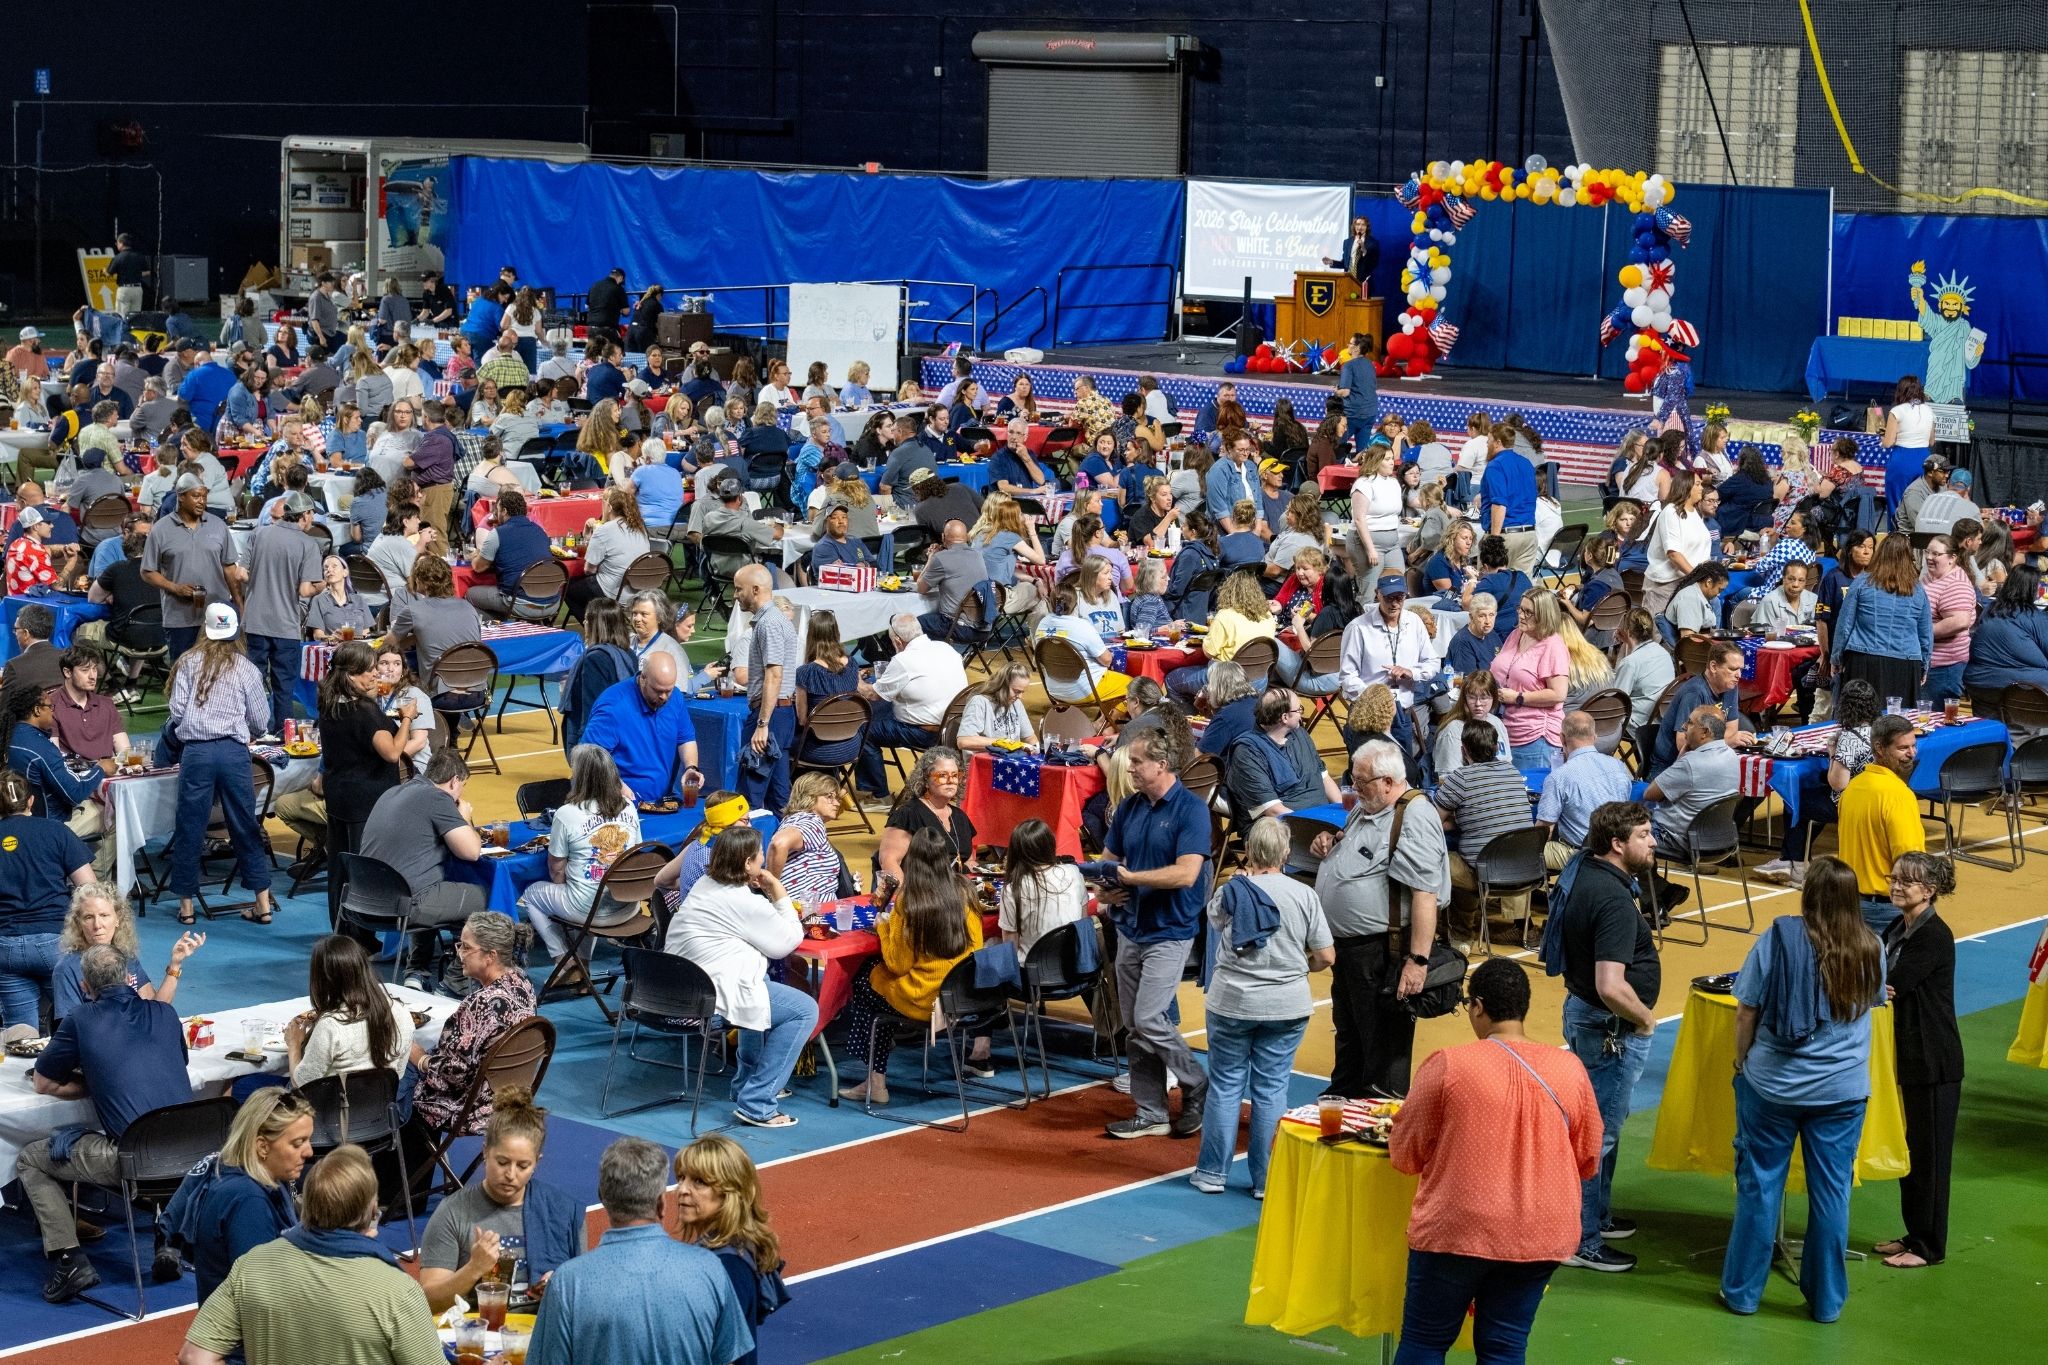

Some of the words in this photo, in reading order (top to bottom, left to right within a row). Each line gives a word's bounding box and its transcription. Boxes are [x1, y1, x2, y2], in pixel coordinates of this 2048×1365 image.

[1194, 210, 1226, 228] 2026
[1229, 210, 1263, 235] Staff
[1266, 212, 1338, 234] Celebration
[1237, 237, 1272, 256] WHITE,
[1276, 240, 1283, 255] &
[1285, 236, 1320, 257] Bucs
[1311, 285, 1328, 306] E
[1088, 611, 1118, 625] ETSU
[582, 815, 606, 836] BORN
